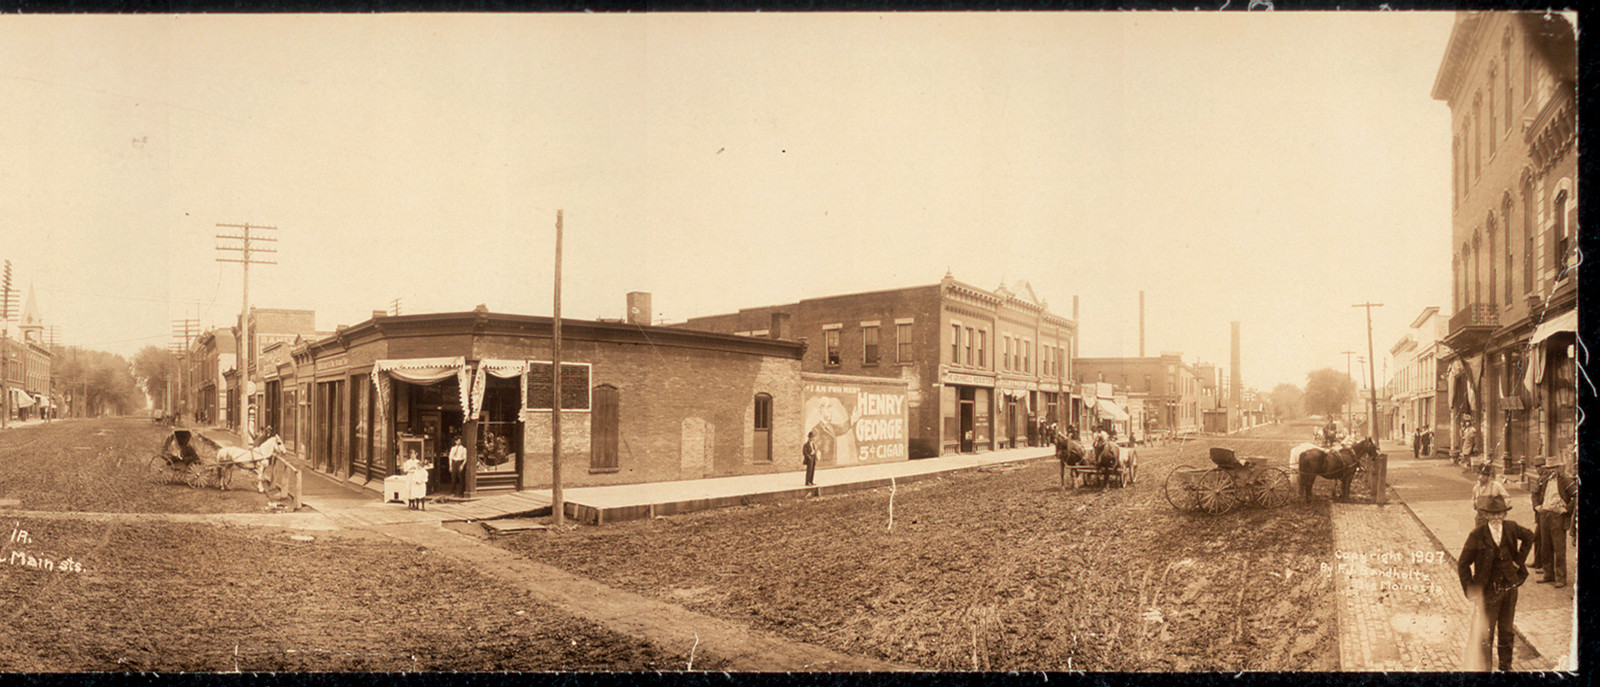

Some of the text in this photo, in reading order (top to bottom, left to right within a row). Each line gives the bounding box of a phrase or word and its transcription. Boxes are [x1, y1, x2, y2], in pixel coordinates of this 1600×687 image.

[858, 392, 905, 415] HENRY
[856, 418, 903, 442] GEORGE
[876, 443, 905, 458] CIGAR
